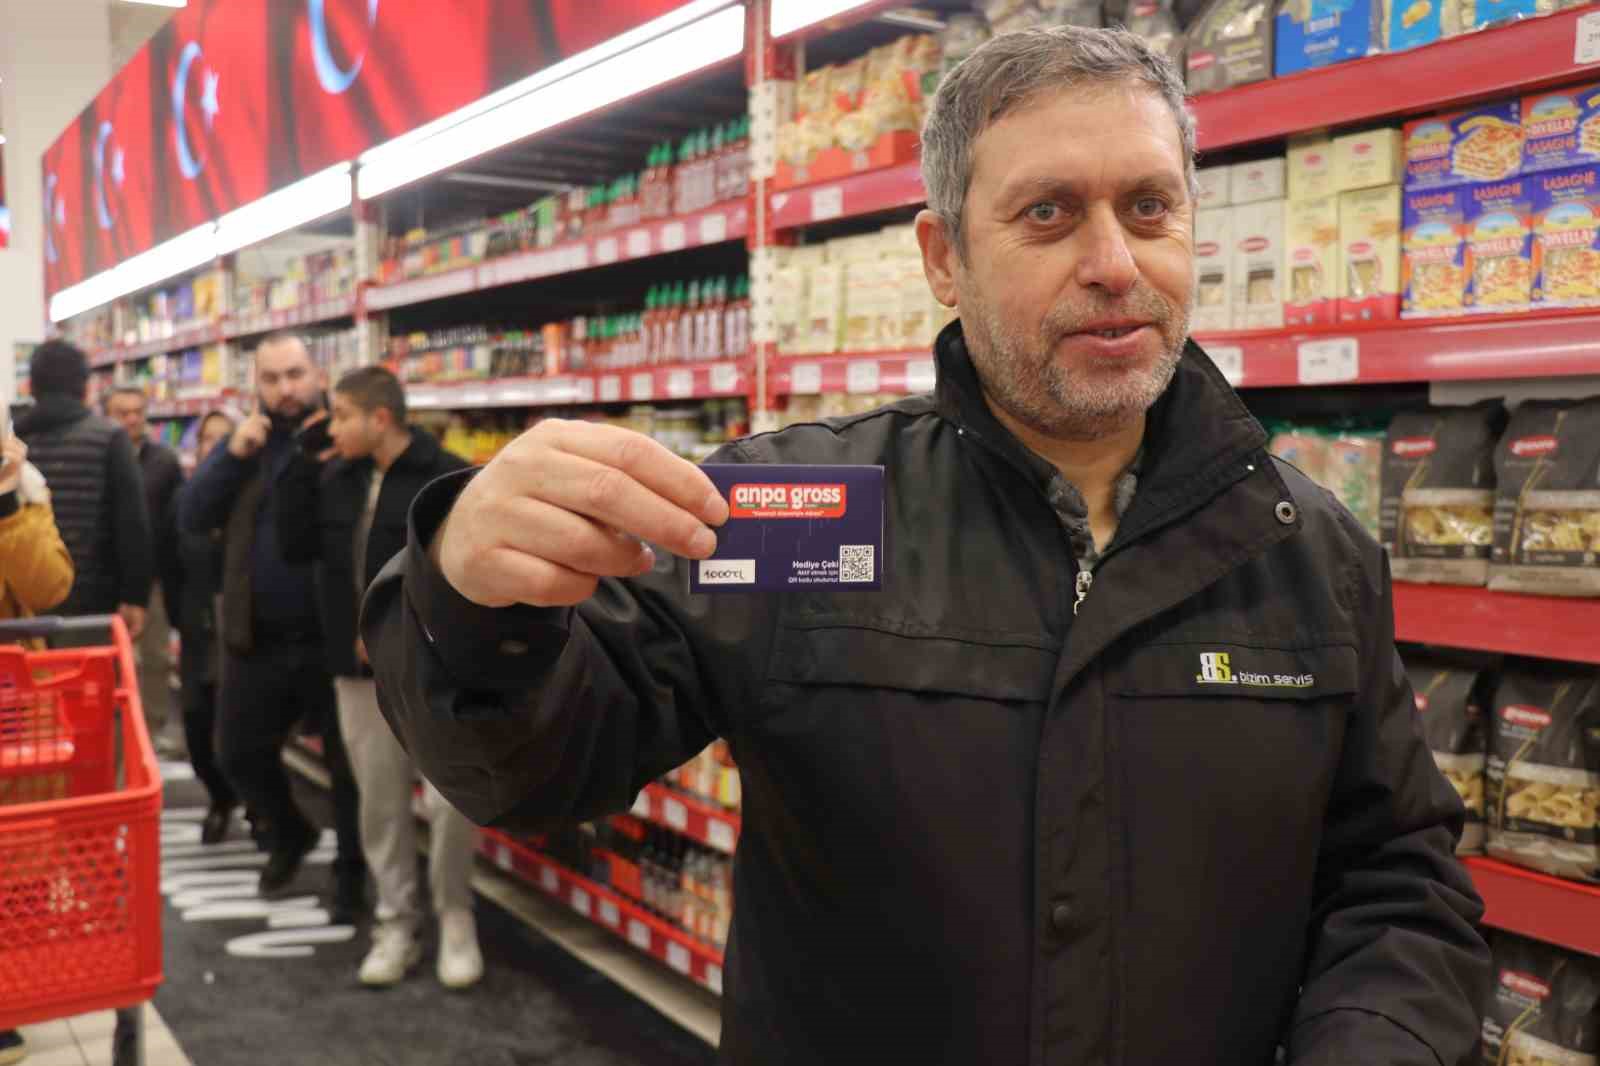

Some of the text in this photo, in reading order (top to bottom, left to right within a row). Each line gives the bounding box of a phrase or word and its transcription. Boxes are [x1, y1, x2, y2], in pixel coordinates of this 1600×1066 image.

[735, 486, 841, 510] anpa gross
[792, 560, 839, 570] Hediye Çeki
[1273, 674, 1314, 686] servis
